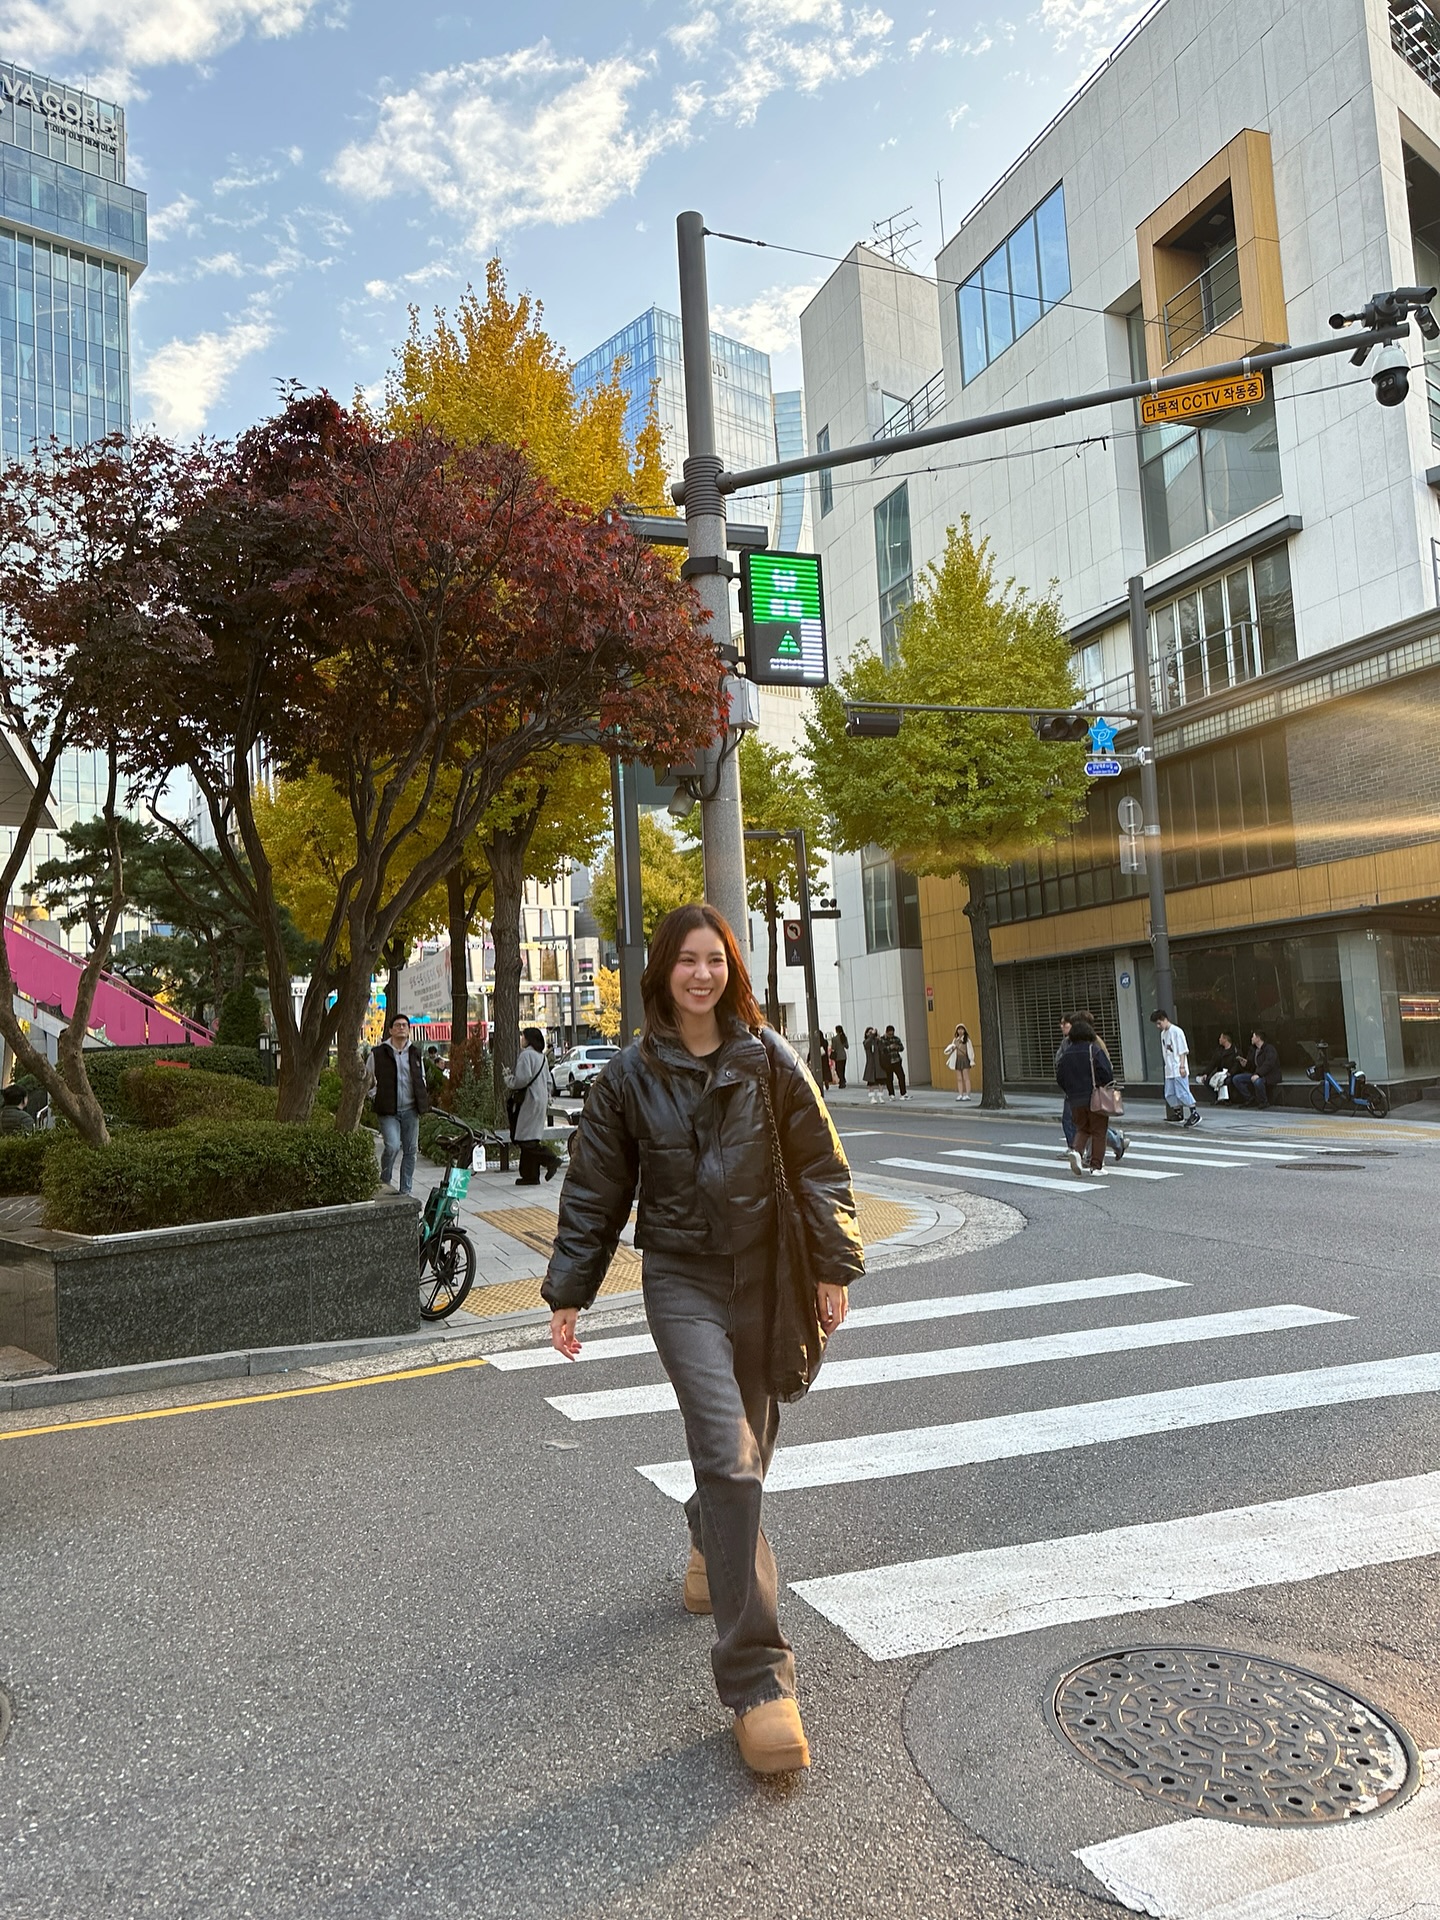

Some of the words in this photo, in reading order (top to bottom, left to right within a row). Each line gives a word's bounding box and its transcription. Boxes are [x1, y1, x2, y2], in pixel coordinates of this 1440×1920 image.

[1146, 399, 1179, 418] 다목적
[1181, 389, 1221, 411] CCTV
[1223, 382, 1259, 401] 작동중
